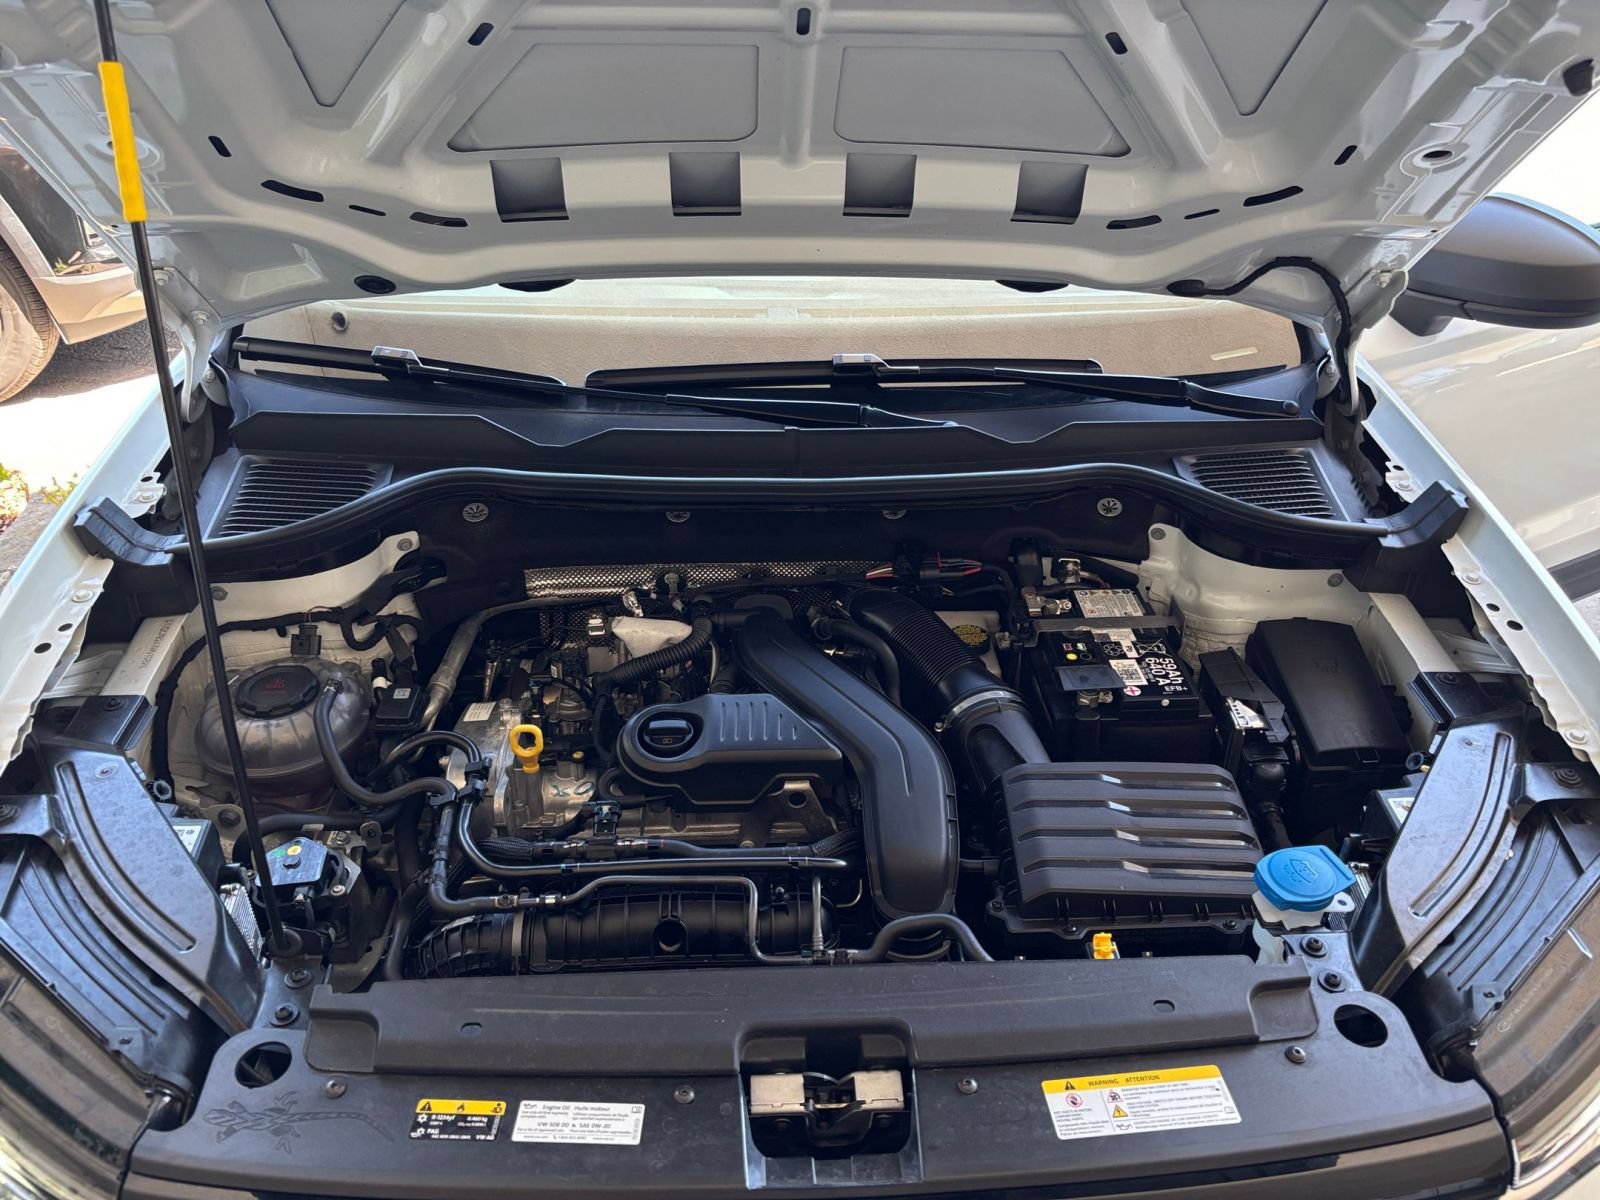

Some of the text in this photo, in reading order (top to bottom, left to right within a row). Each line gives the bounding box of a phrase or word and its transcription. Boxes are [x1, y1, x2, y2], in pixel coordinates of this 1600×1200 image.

[1145, 657, 1166, 676] 640
[1160, 657, 1184, 684] 59Ah
[1155, 677, 1172, 686] A
[1087, 1074, 1160, 1087] WARNING ATTENTION
